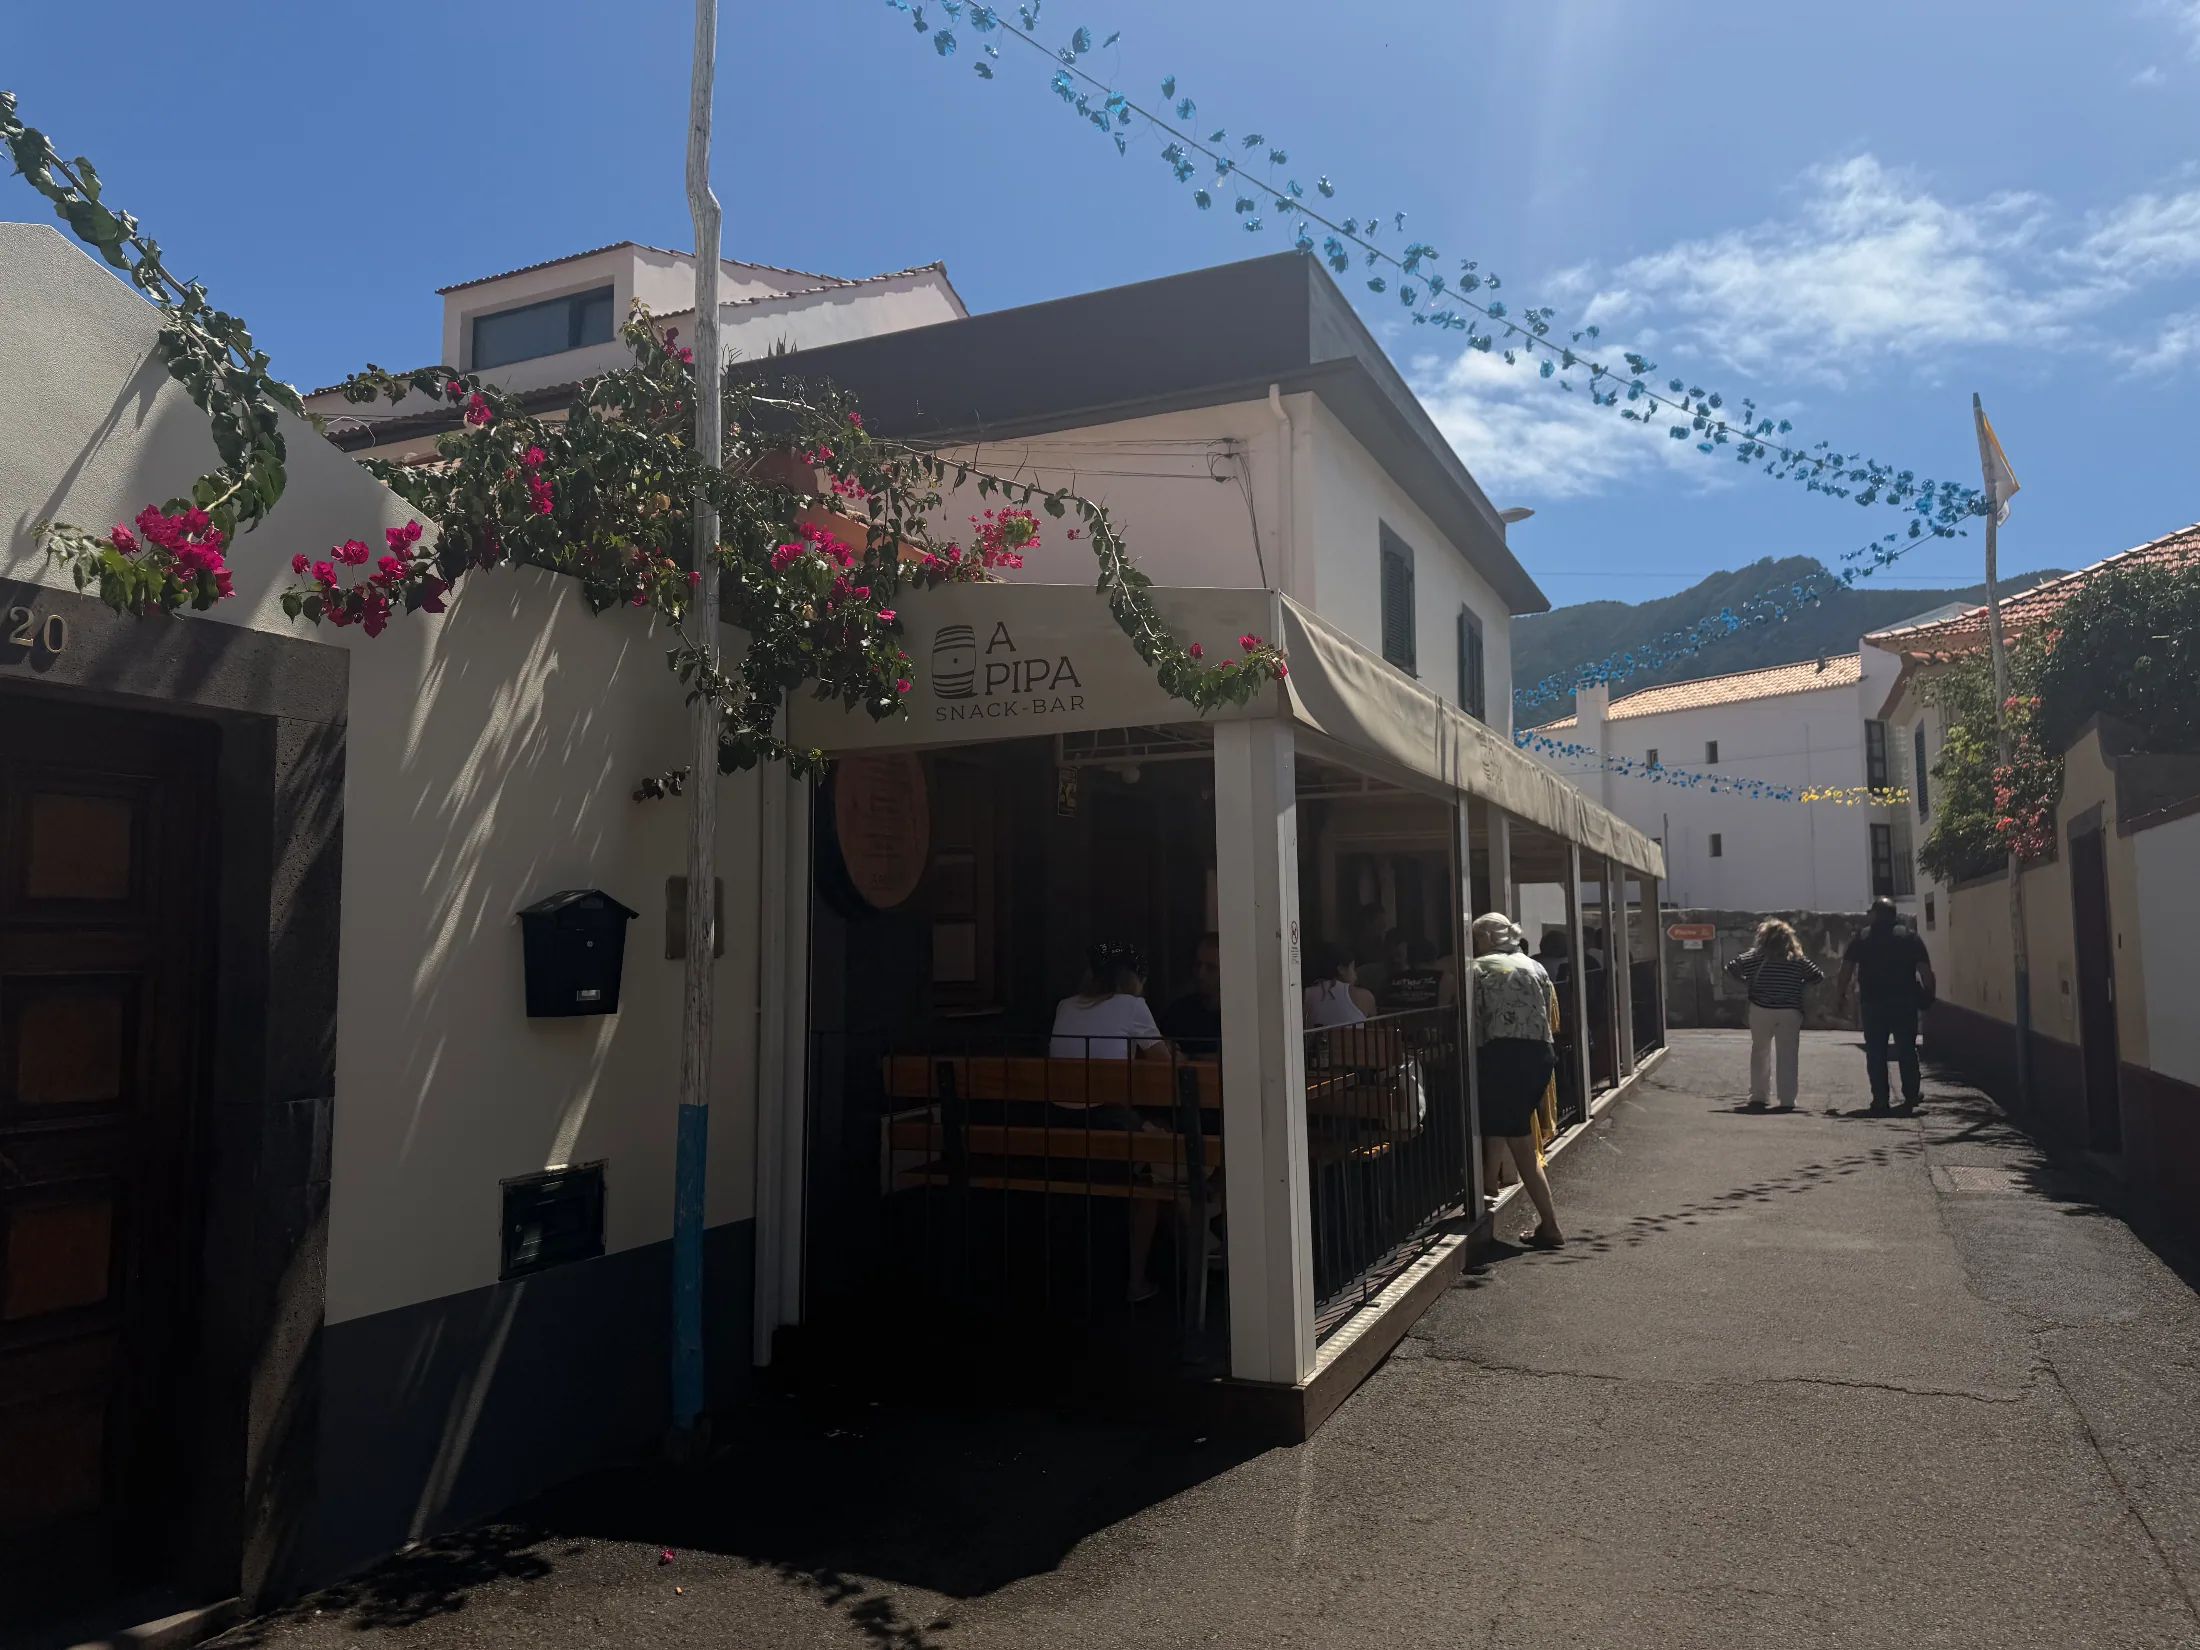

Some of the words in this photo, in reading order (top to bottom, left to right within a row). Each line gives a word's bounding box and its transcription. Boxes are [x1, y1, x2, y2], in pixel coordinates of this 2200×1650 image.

[9, 606, 69, 654] 20
[985, 621, 1017, 654] A
[985, 656, 1082, 696] PIPA
[936, 695, 1085, 721] SNACK-BAR
